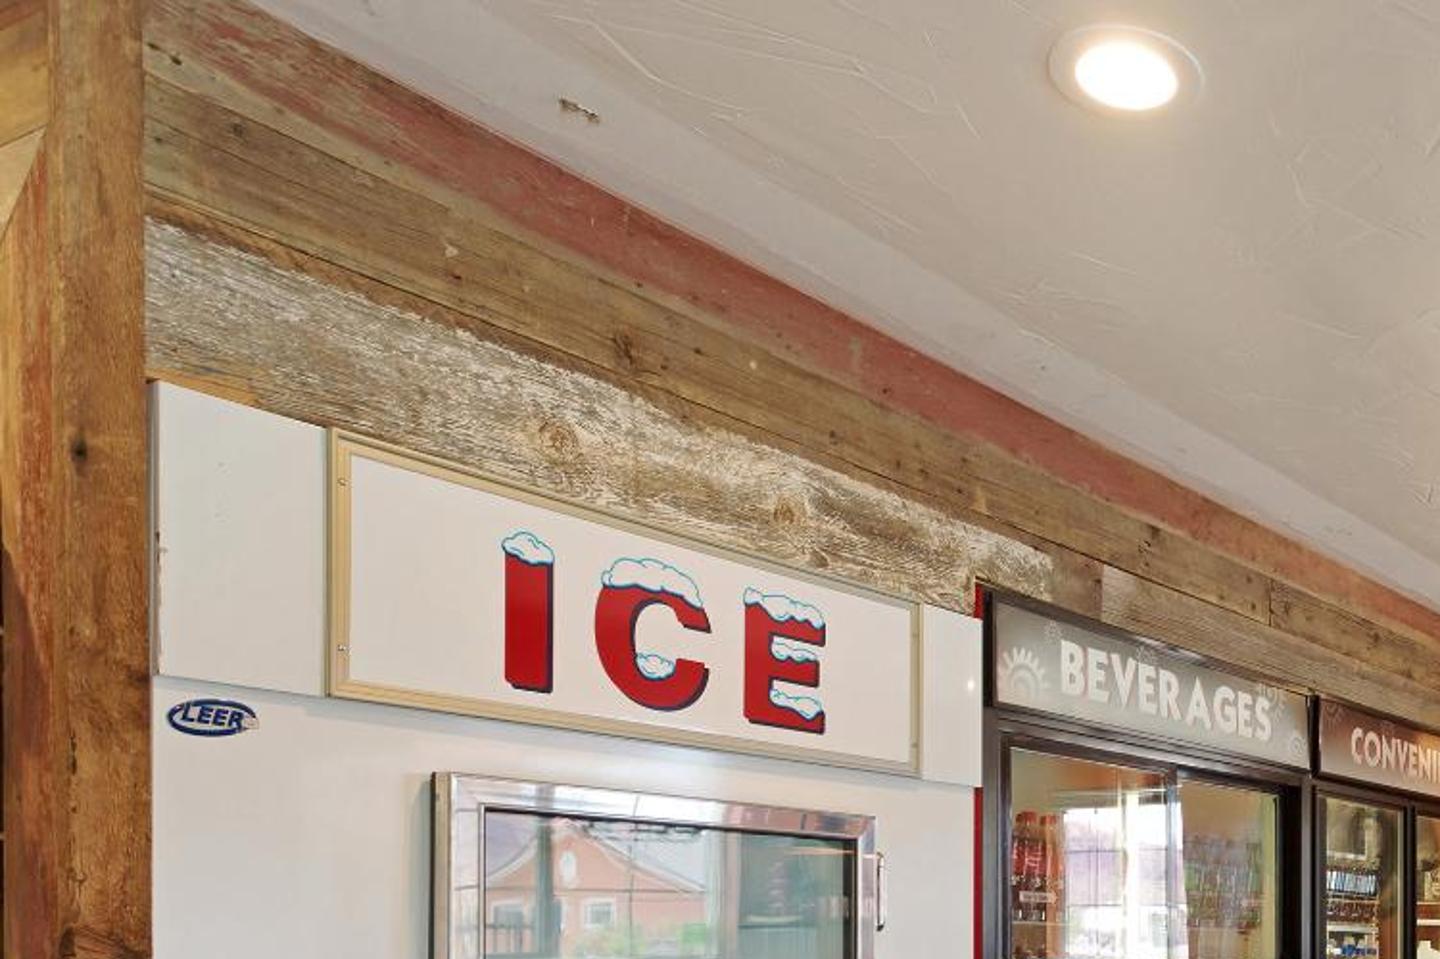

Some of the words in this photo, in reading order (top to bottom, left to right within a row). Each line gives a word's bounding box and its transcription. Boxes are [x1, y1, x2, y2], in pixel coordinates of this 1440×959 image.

[501, 531, 826, 734] ICE
[181, 702, 243, 731] LEER
[1060, 639, 1272, 742] BEVERAGES
